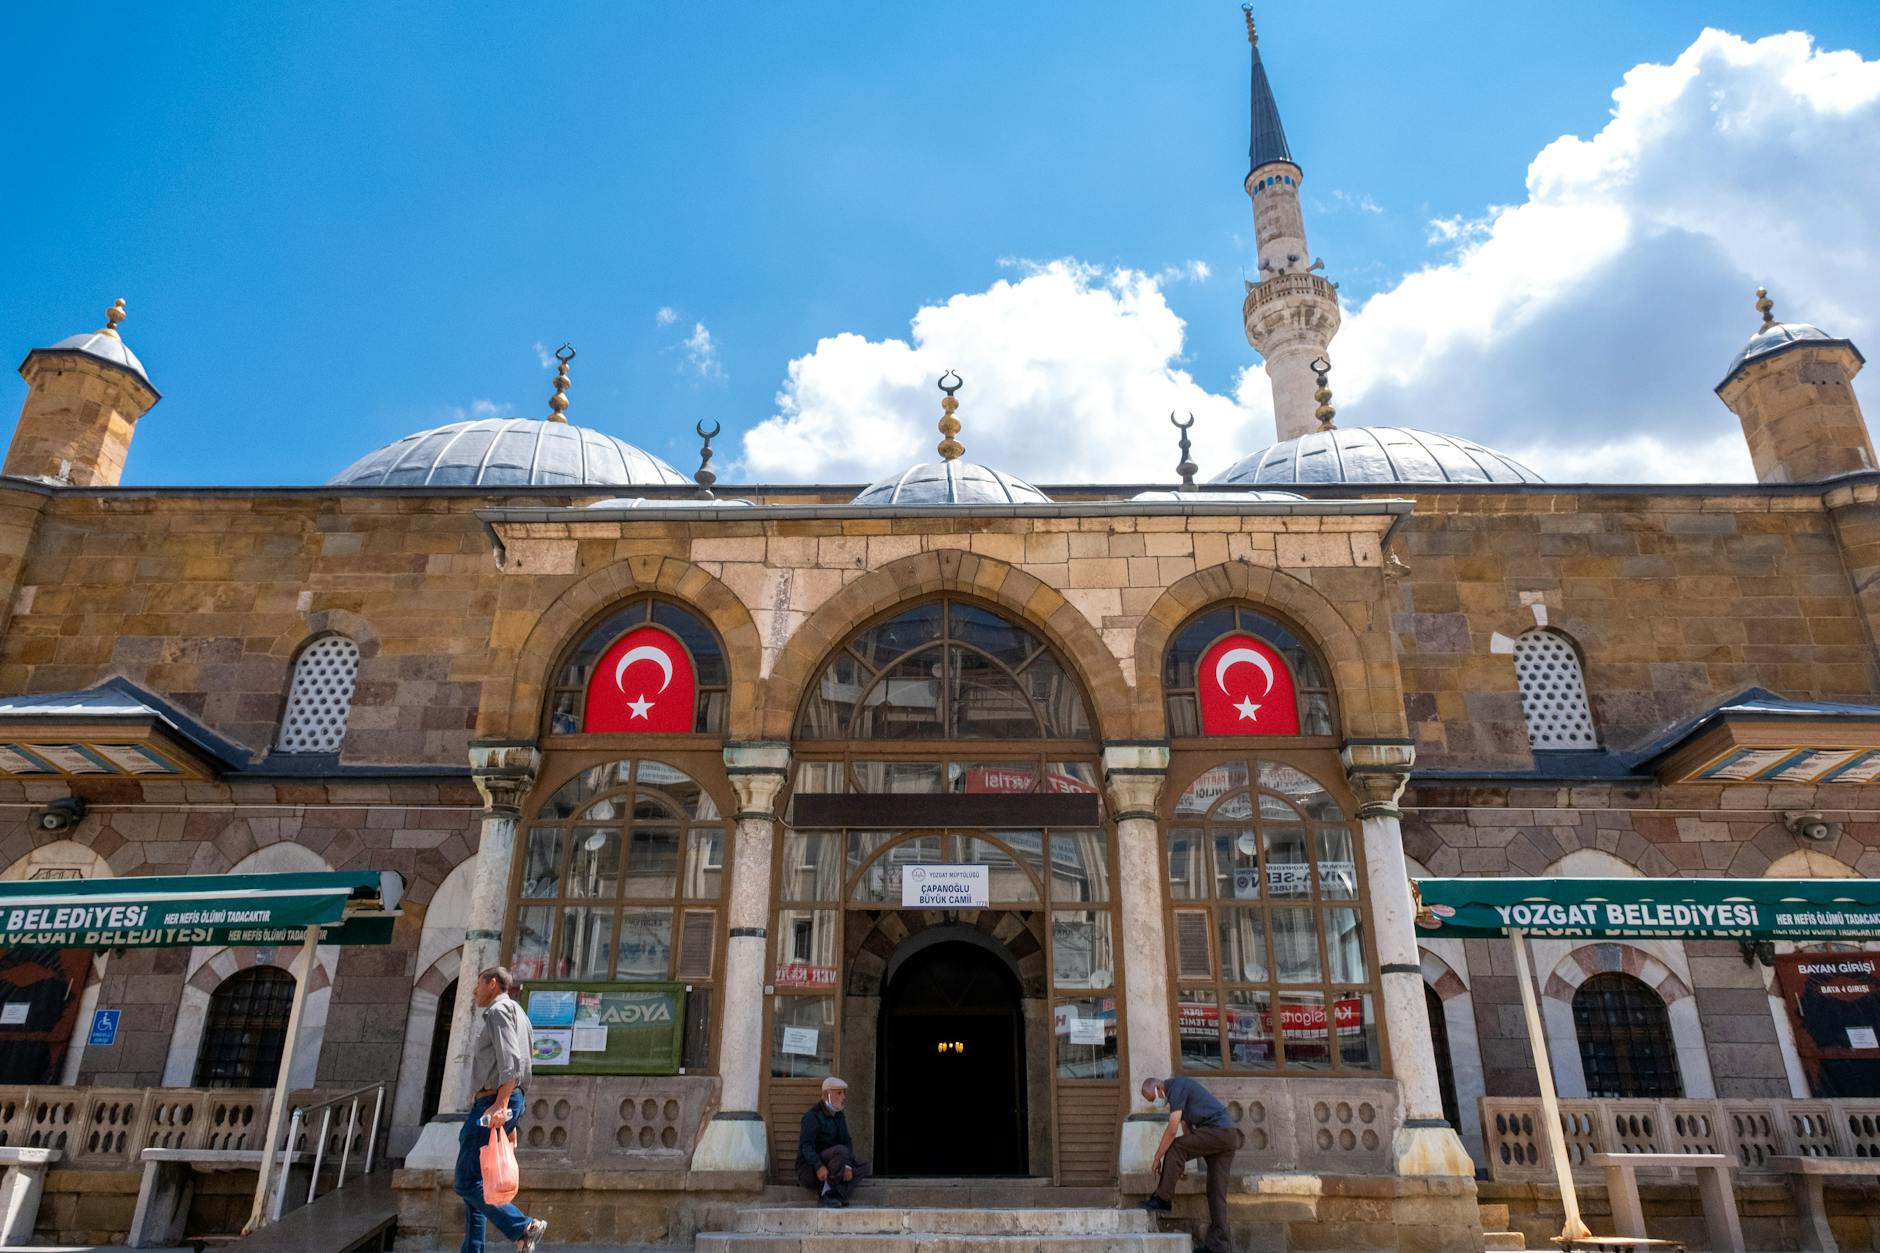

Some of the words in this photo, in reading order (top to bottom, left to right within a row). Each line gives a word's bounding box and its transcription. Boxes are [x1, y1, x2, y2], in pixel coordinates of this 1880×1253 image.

[921, 883, 970, 894] ÇAPANOĞLU
[919, 893, 947, 904] BÜYÜK
[164, 913, 180, 925] HER
[180, 910, 200, 924] NEFİS
[200, 909, 226, 924] ÖLÜMÜ
[227, 910, 271, 923] TADACAKTIR
[1494, 904, 1598, 925] YOZGAT
[1775, 913, 1794, 925] HER
[1793, 911, 1817, 925] NEFİS
[1817, 911, 1844, 925] ÖLÜMÜ
[228, 929, 242, 941] HER
[1798, 964, 1837, 974] BAYAN
[1838, 960, 1876, 975] GİRİŞİ
